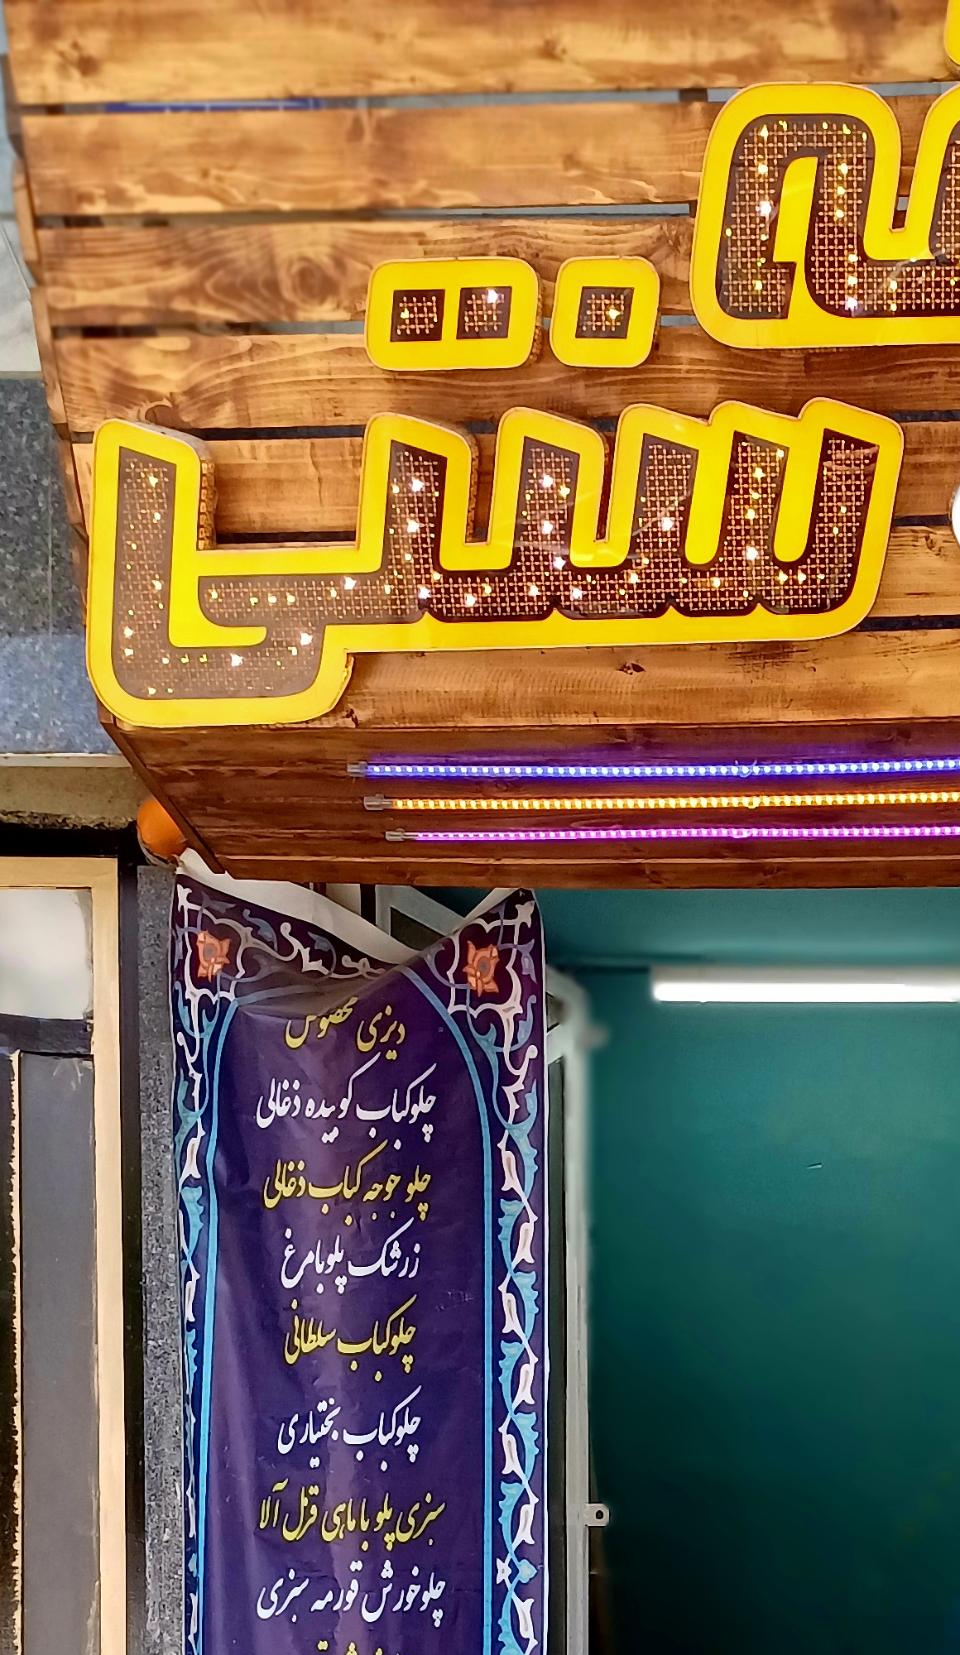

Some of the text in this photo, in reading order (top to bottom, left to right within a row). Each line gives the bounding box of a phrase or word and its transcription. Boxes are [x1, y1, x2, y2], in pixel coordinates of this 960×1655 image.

[88, 255, 904, 726] سنتی
[284, 996, 406, 1061] دیزی مخصوص
[256, 1078, 300, 1129] ذغالی
[305, 1052, 380, 1143] کوبیده
[263, 1140, 432, 1226] چلو جوجه کباب ذغالی
[347, 1217, 420, 1278] زرشک
[284, 1299, 337, 1365] سلطانی
[277, 1396, 342, 1469] بختیاری
[259, 1479, 446, 1552] سبزی پلو با ماهی قزل آلا
[256, 1567, 310, 1623] سبزی
[311, 1560, 360, 1612] قورمه
